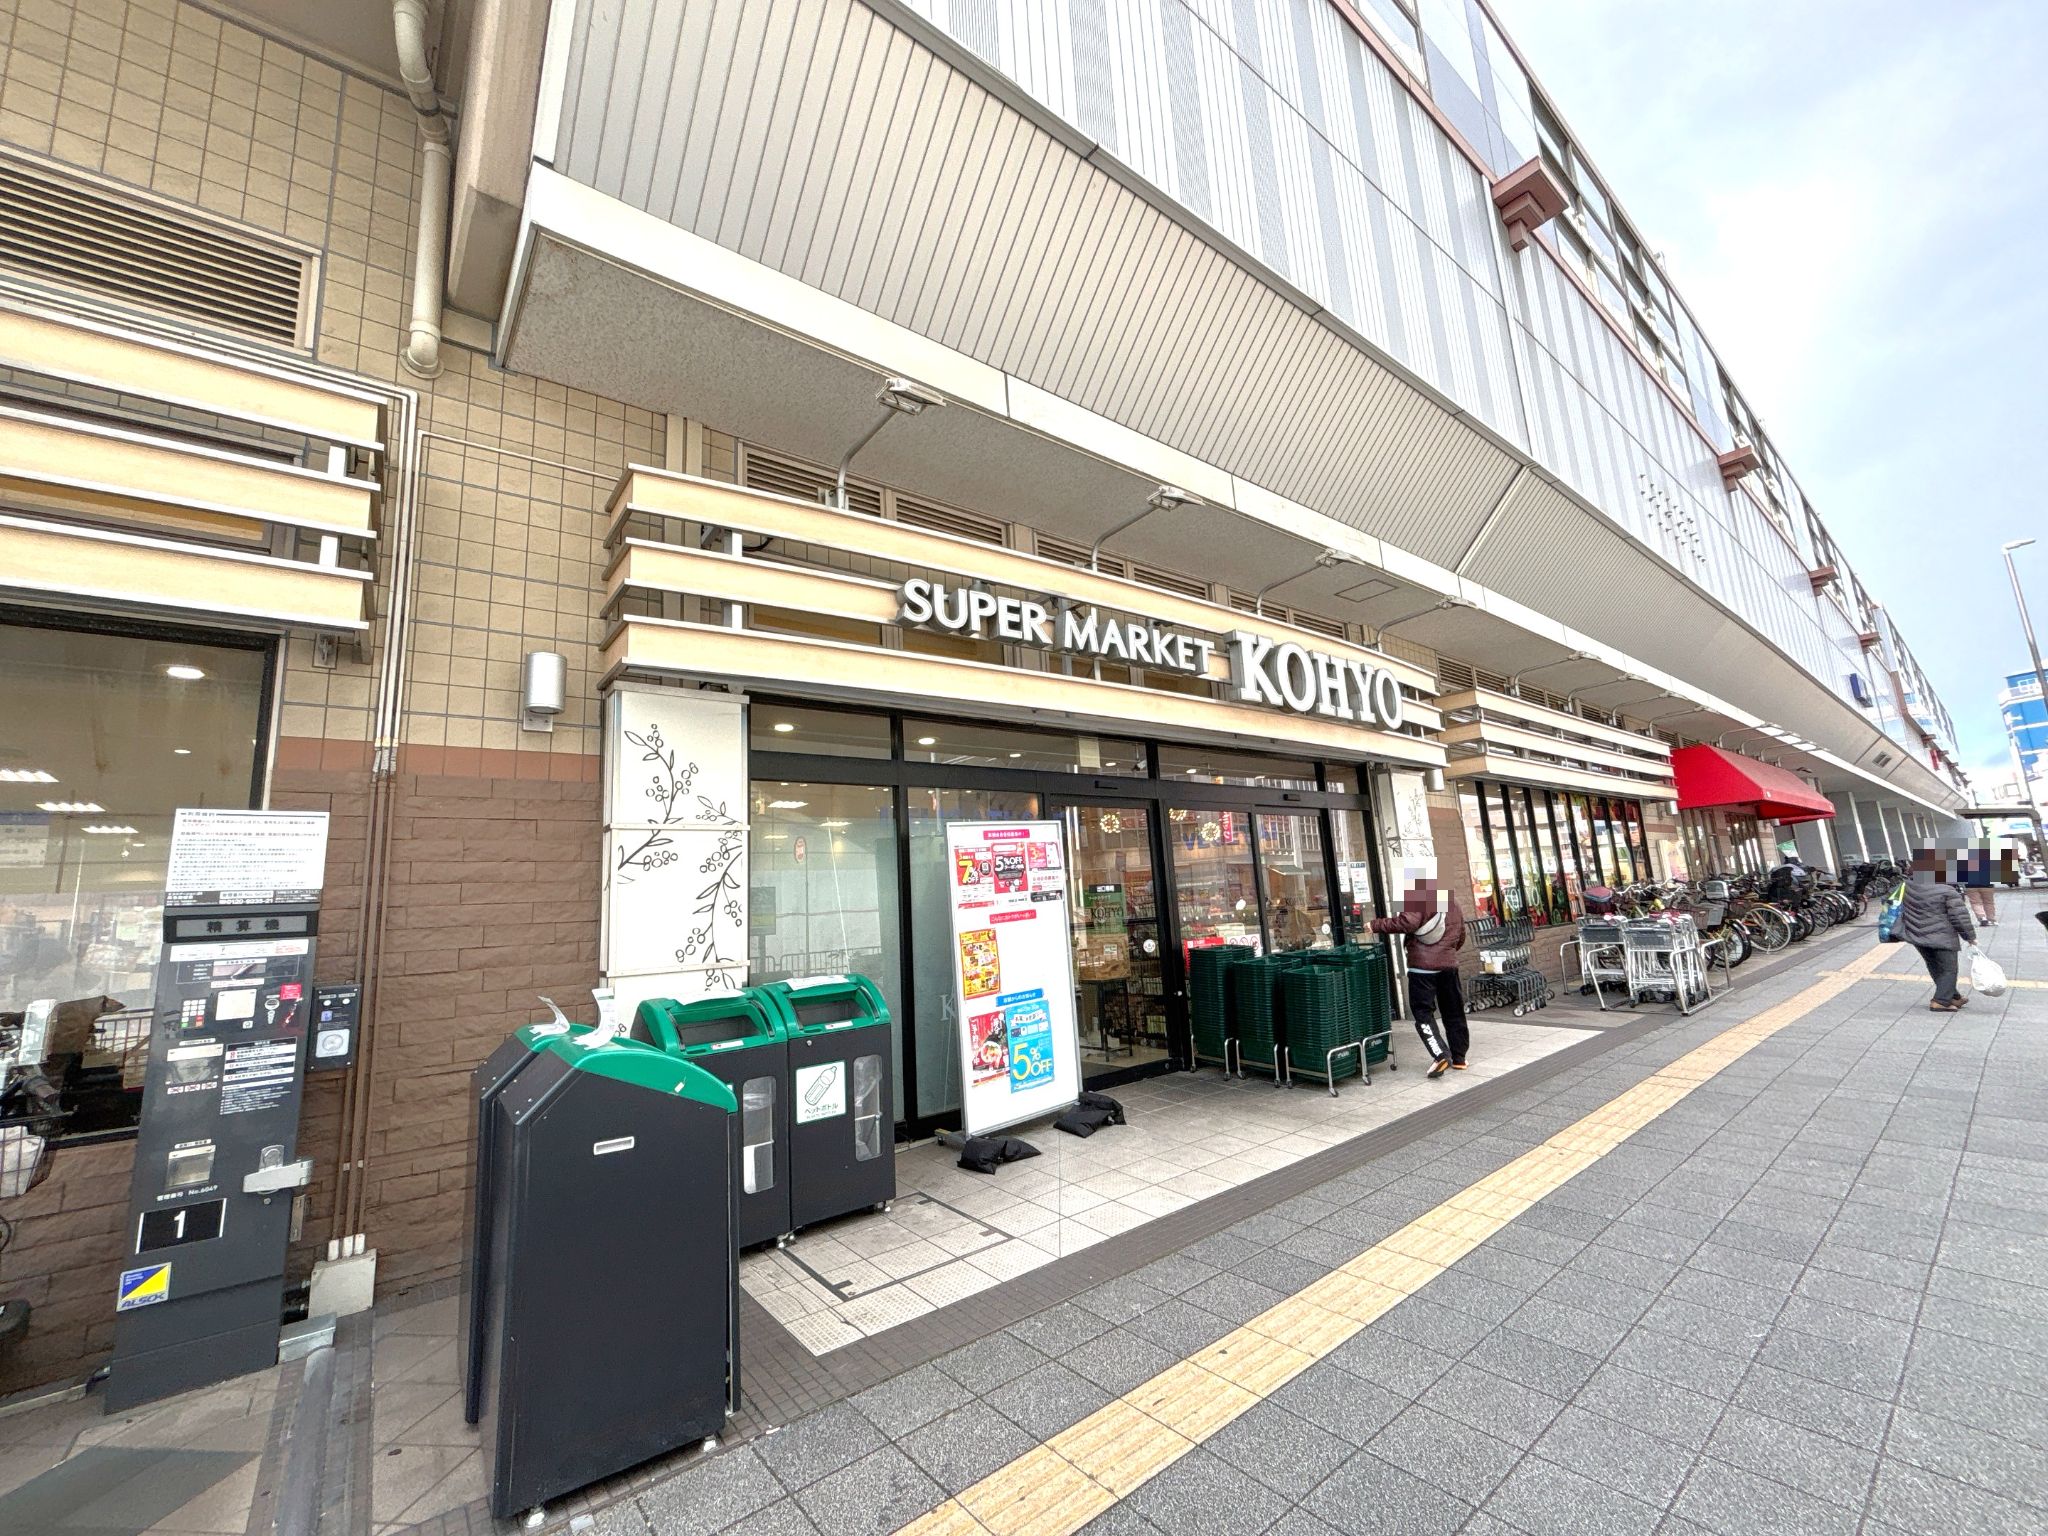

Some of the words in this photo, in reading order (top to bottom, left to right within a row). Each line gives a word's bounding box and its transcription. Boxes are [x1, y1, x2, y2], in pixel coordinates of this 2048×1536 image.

[899, 578, 1052, 647] SUPER
[1056, 607, 1215, 676] MARKET
[1227, 628, 1404, 732] KOHYO
[174, 1210, 186, 1239] 1
[121, 1292, 166, 1308] ALSOK
